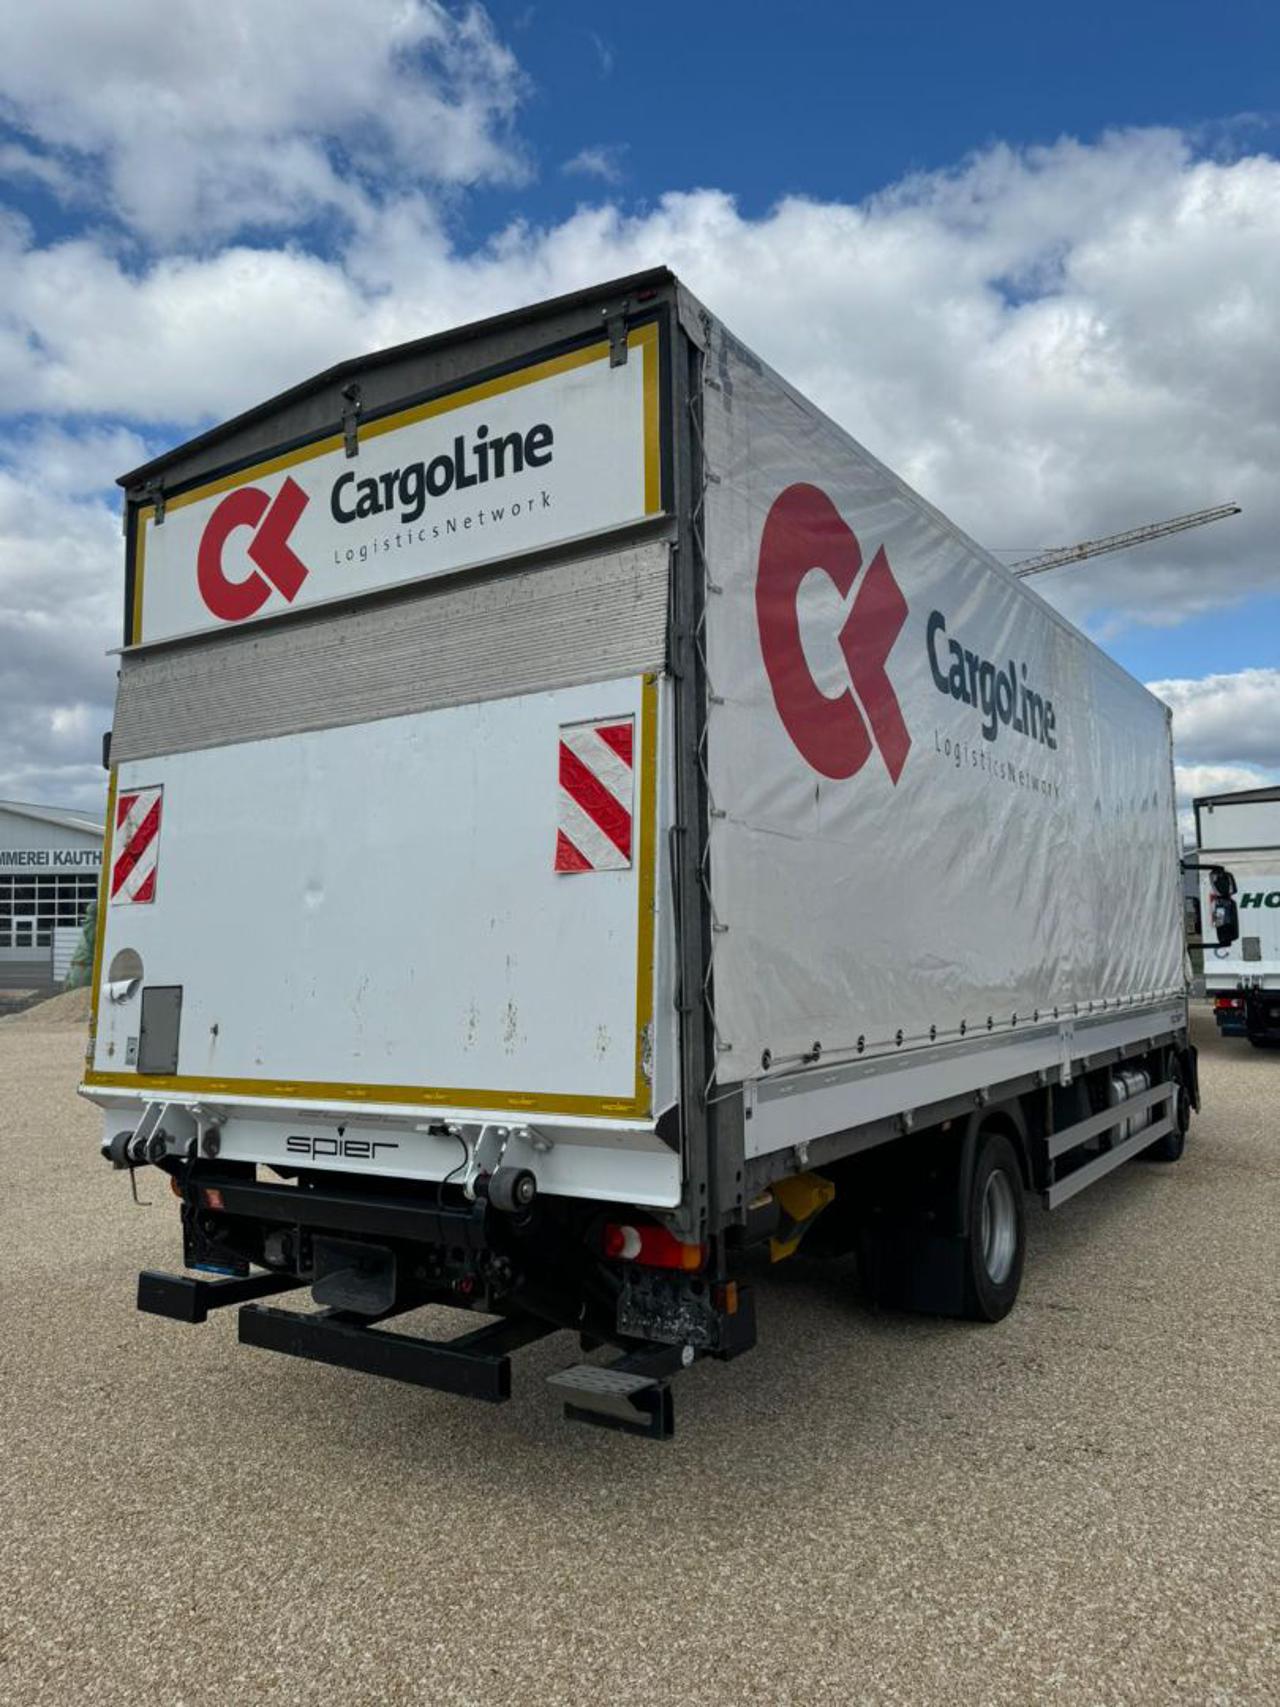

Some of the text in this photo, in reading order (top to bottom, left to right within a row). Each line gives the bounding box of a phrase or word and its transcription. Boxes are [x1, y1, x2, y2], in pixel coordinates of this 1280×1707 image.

[330, 423, 555, 524] CargoLine
[334, 491, 551, 563] LogisticsNetwork
[926, 609, 1058, 750] CargoLine
[286, 1126, 399, 1161] spier
